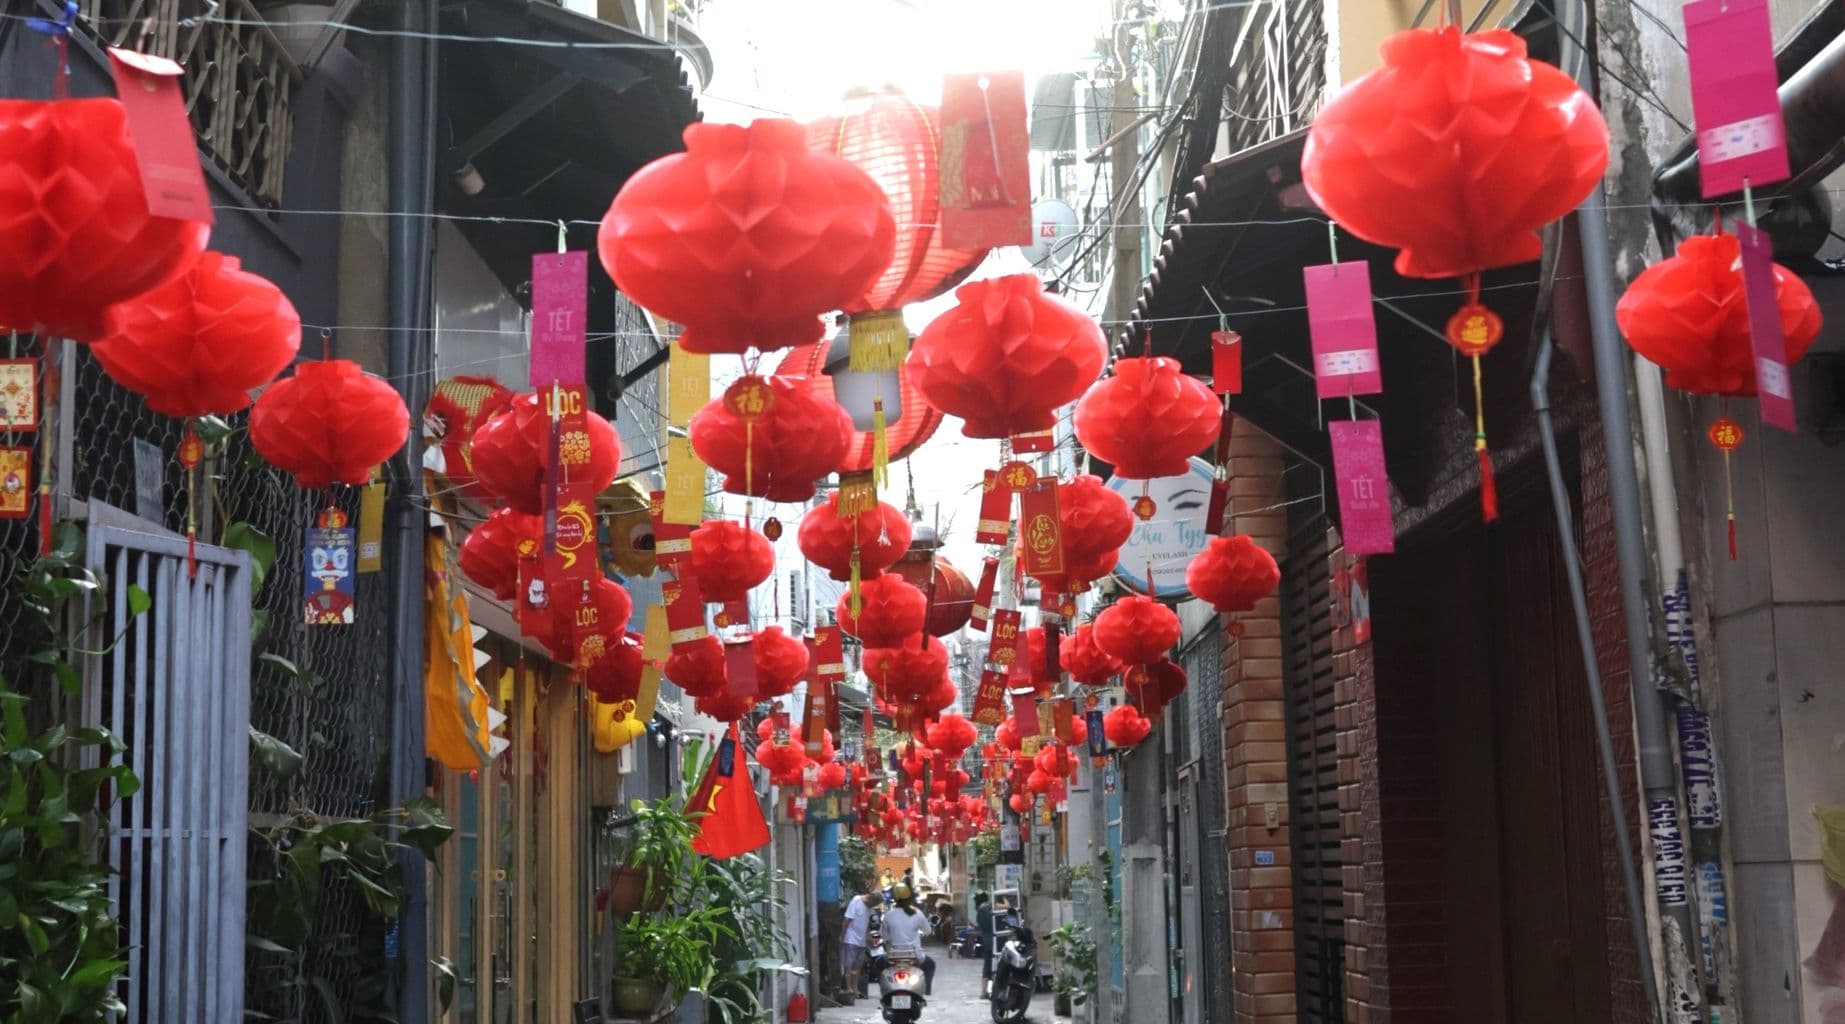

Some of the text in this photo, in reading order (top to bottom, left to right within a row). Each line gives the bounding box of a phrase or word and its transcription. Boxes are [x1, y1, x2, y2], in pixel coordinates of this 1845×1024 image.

[547, 305, 574, 332] TẾT
[545, 388, 581, 419] LỘC
[1006, 466, 1028, 488] 福
[1350, 472, 1374, 500] TẾT
[575, 606, 599, 627] LỘC
[996, 623, 1017, 641] LỘC
[982, 683, 1003, 701] LỘC
